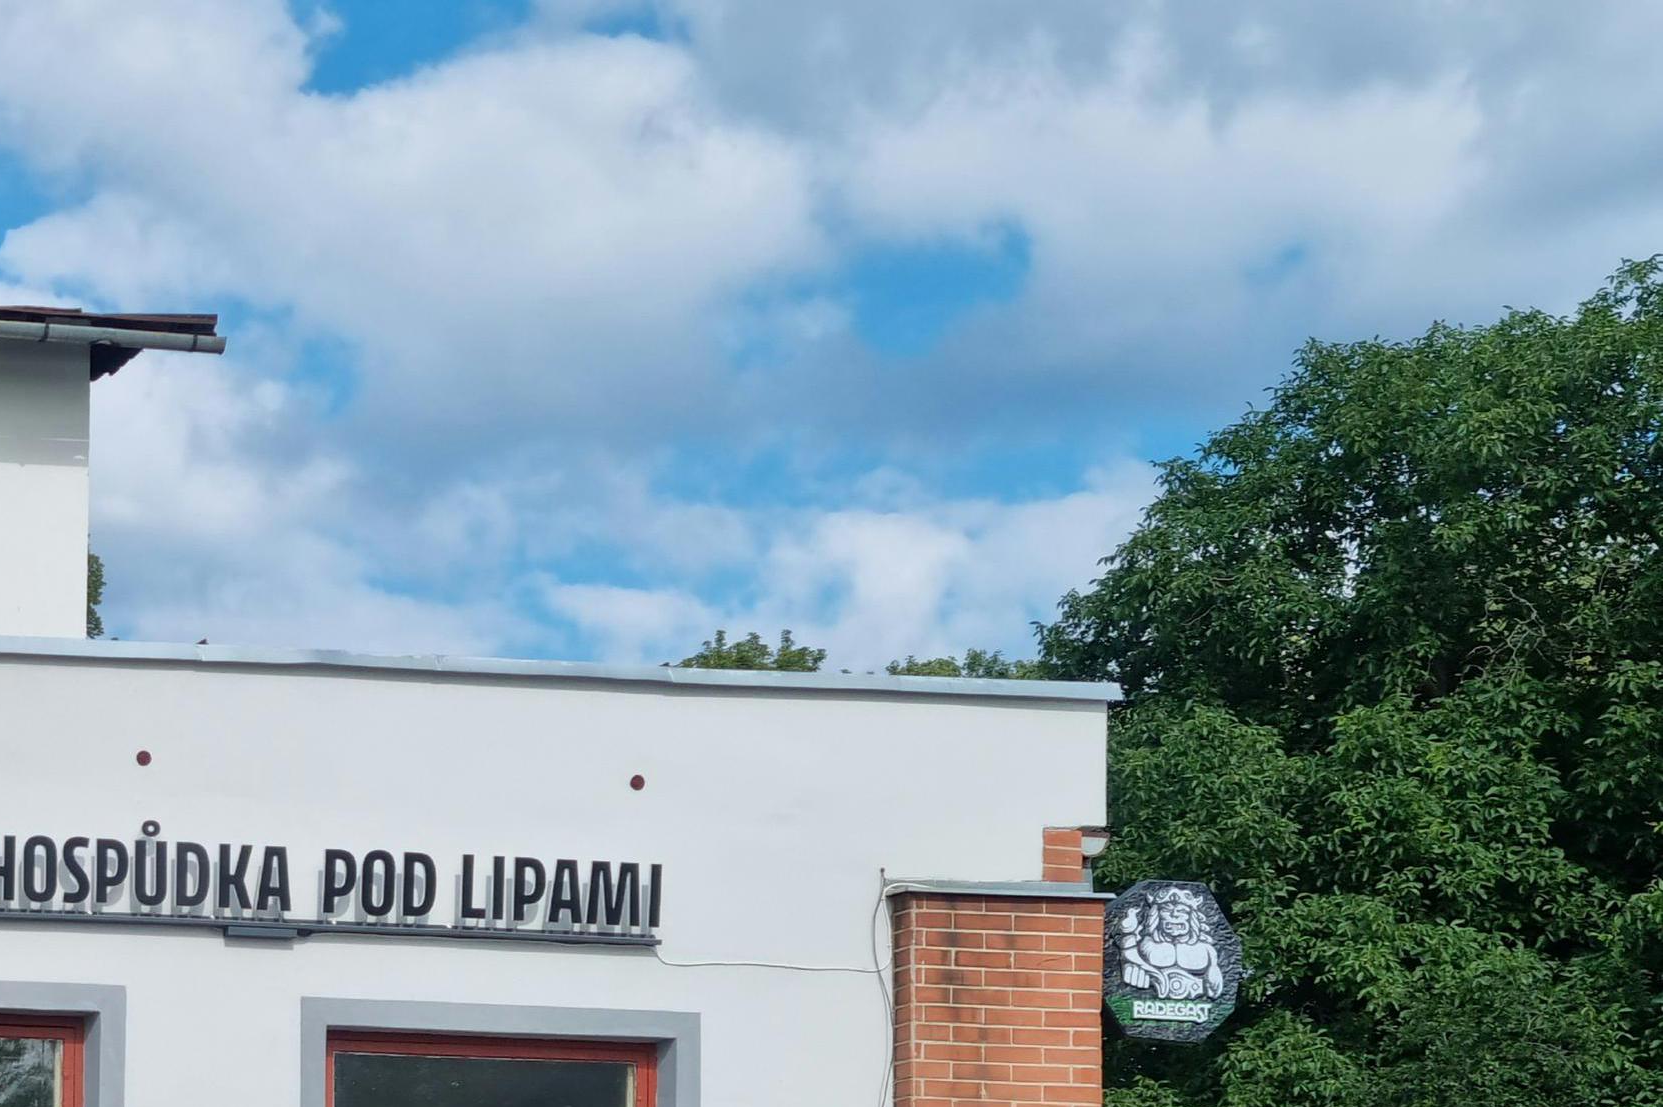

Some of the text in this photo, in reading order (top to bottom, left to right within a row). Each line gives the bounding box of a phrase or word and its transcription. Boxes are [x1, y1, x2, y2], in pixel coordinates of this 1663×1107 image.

[323, 849, 437, 917] POD
[461, 854, 662, 928] LIPAMI
[1133, 1001, 1212, 1023] RADEGAST
